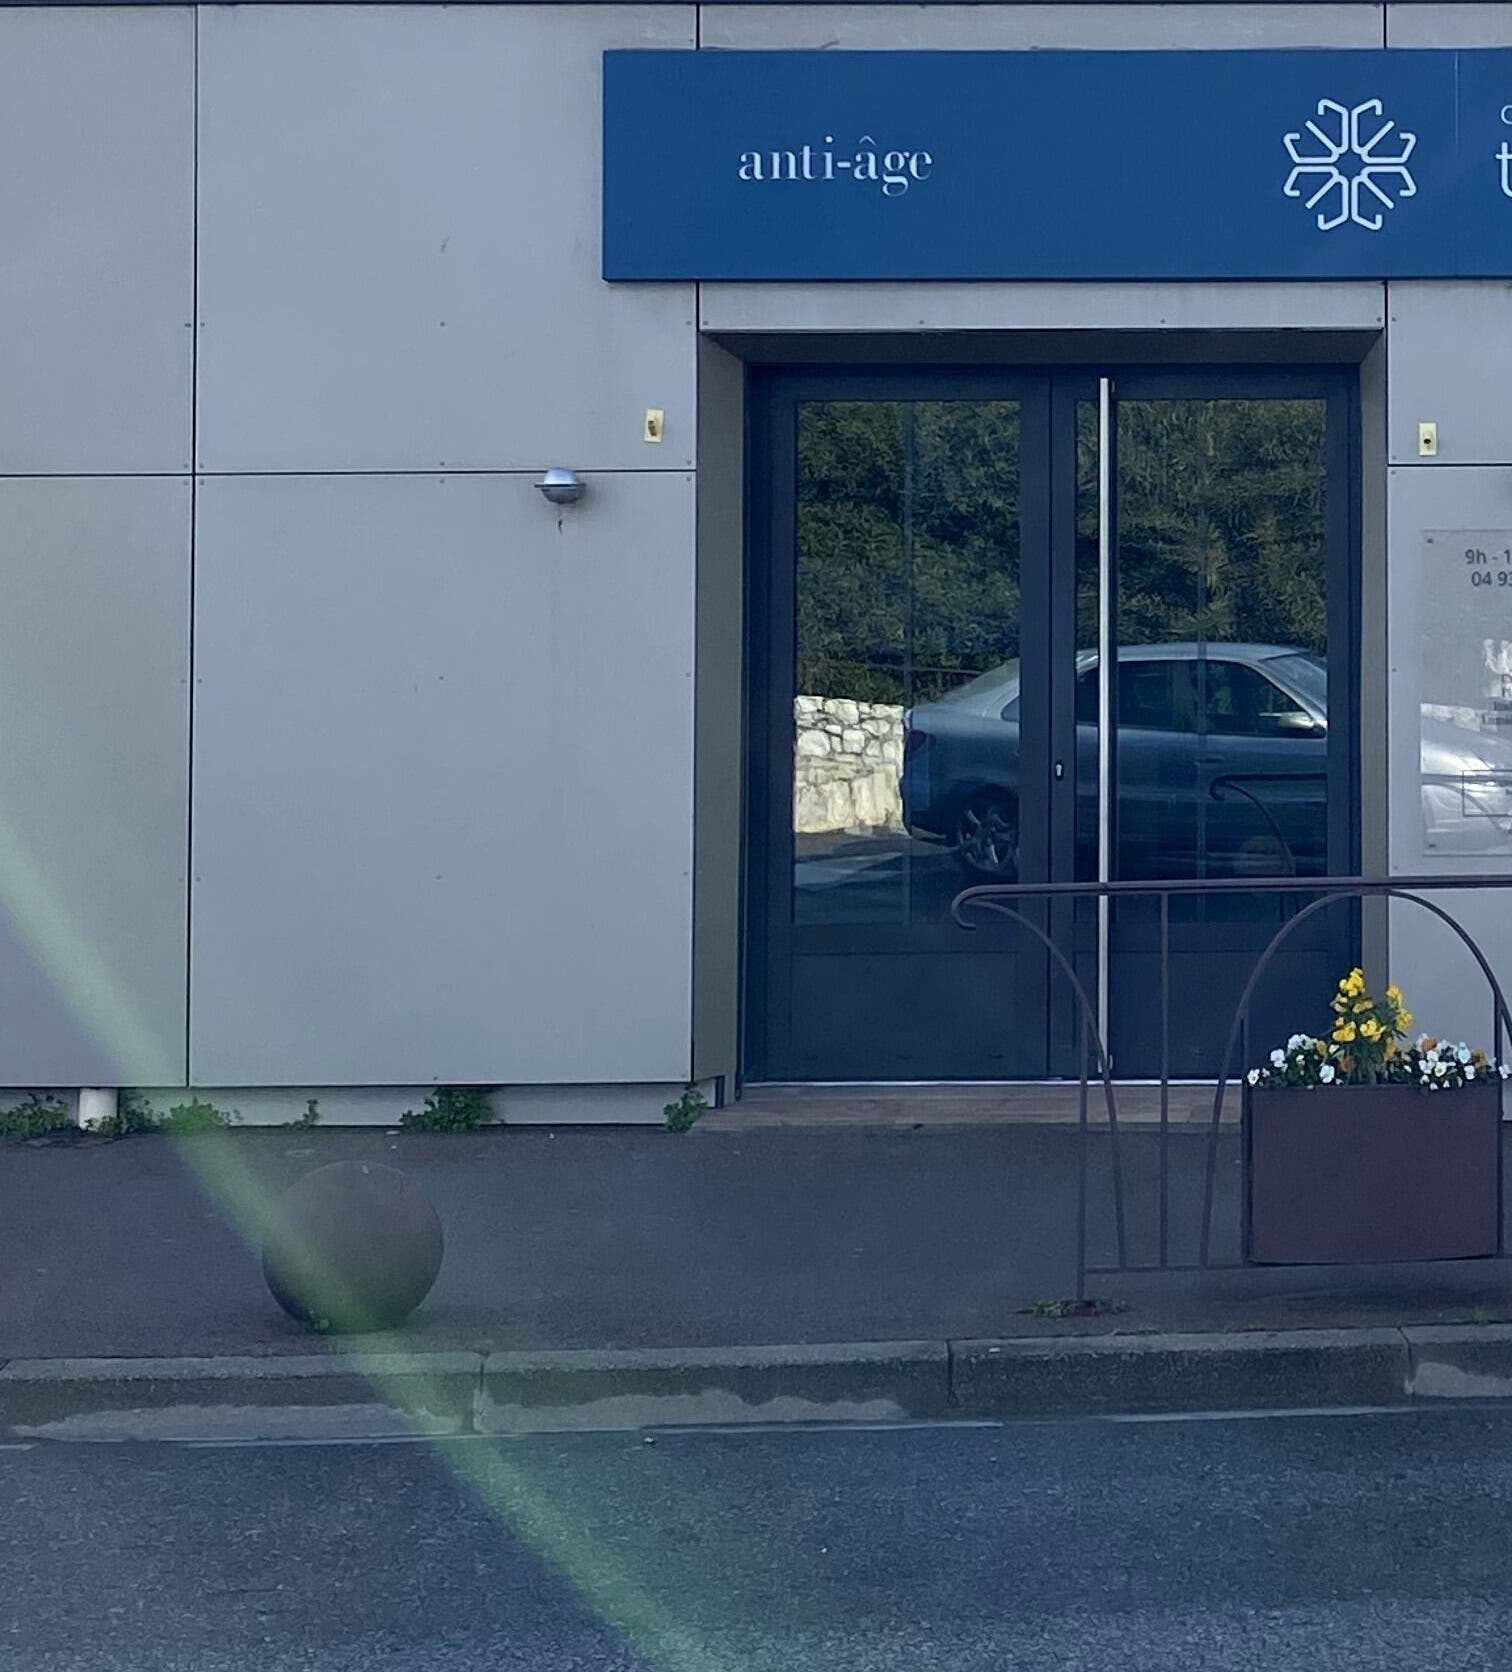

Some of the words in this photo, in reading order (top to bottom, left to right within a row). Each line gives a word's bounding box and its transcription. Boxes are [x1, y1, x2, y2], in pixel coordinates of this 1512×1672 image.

[738, 135, 933, 197] anti-âge
[1464, 548, 1487, 565] 9h
[1471, 571, 1493, 587] 04
